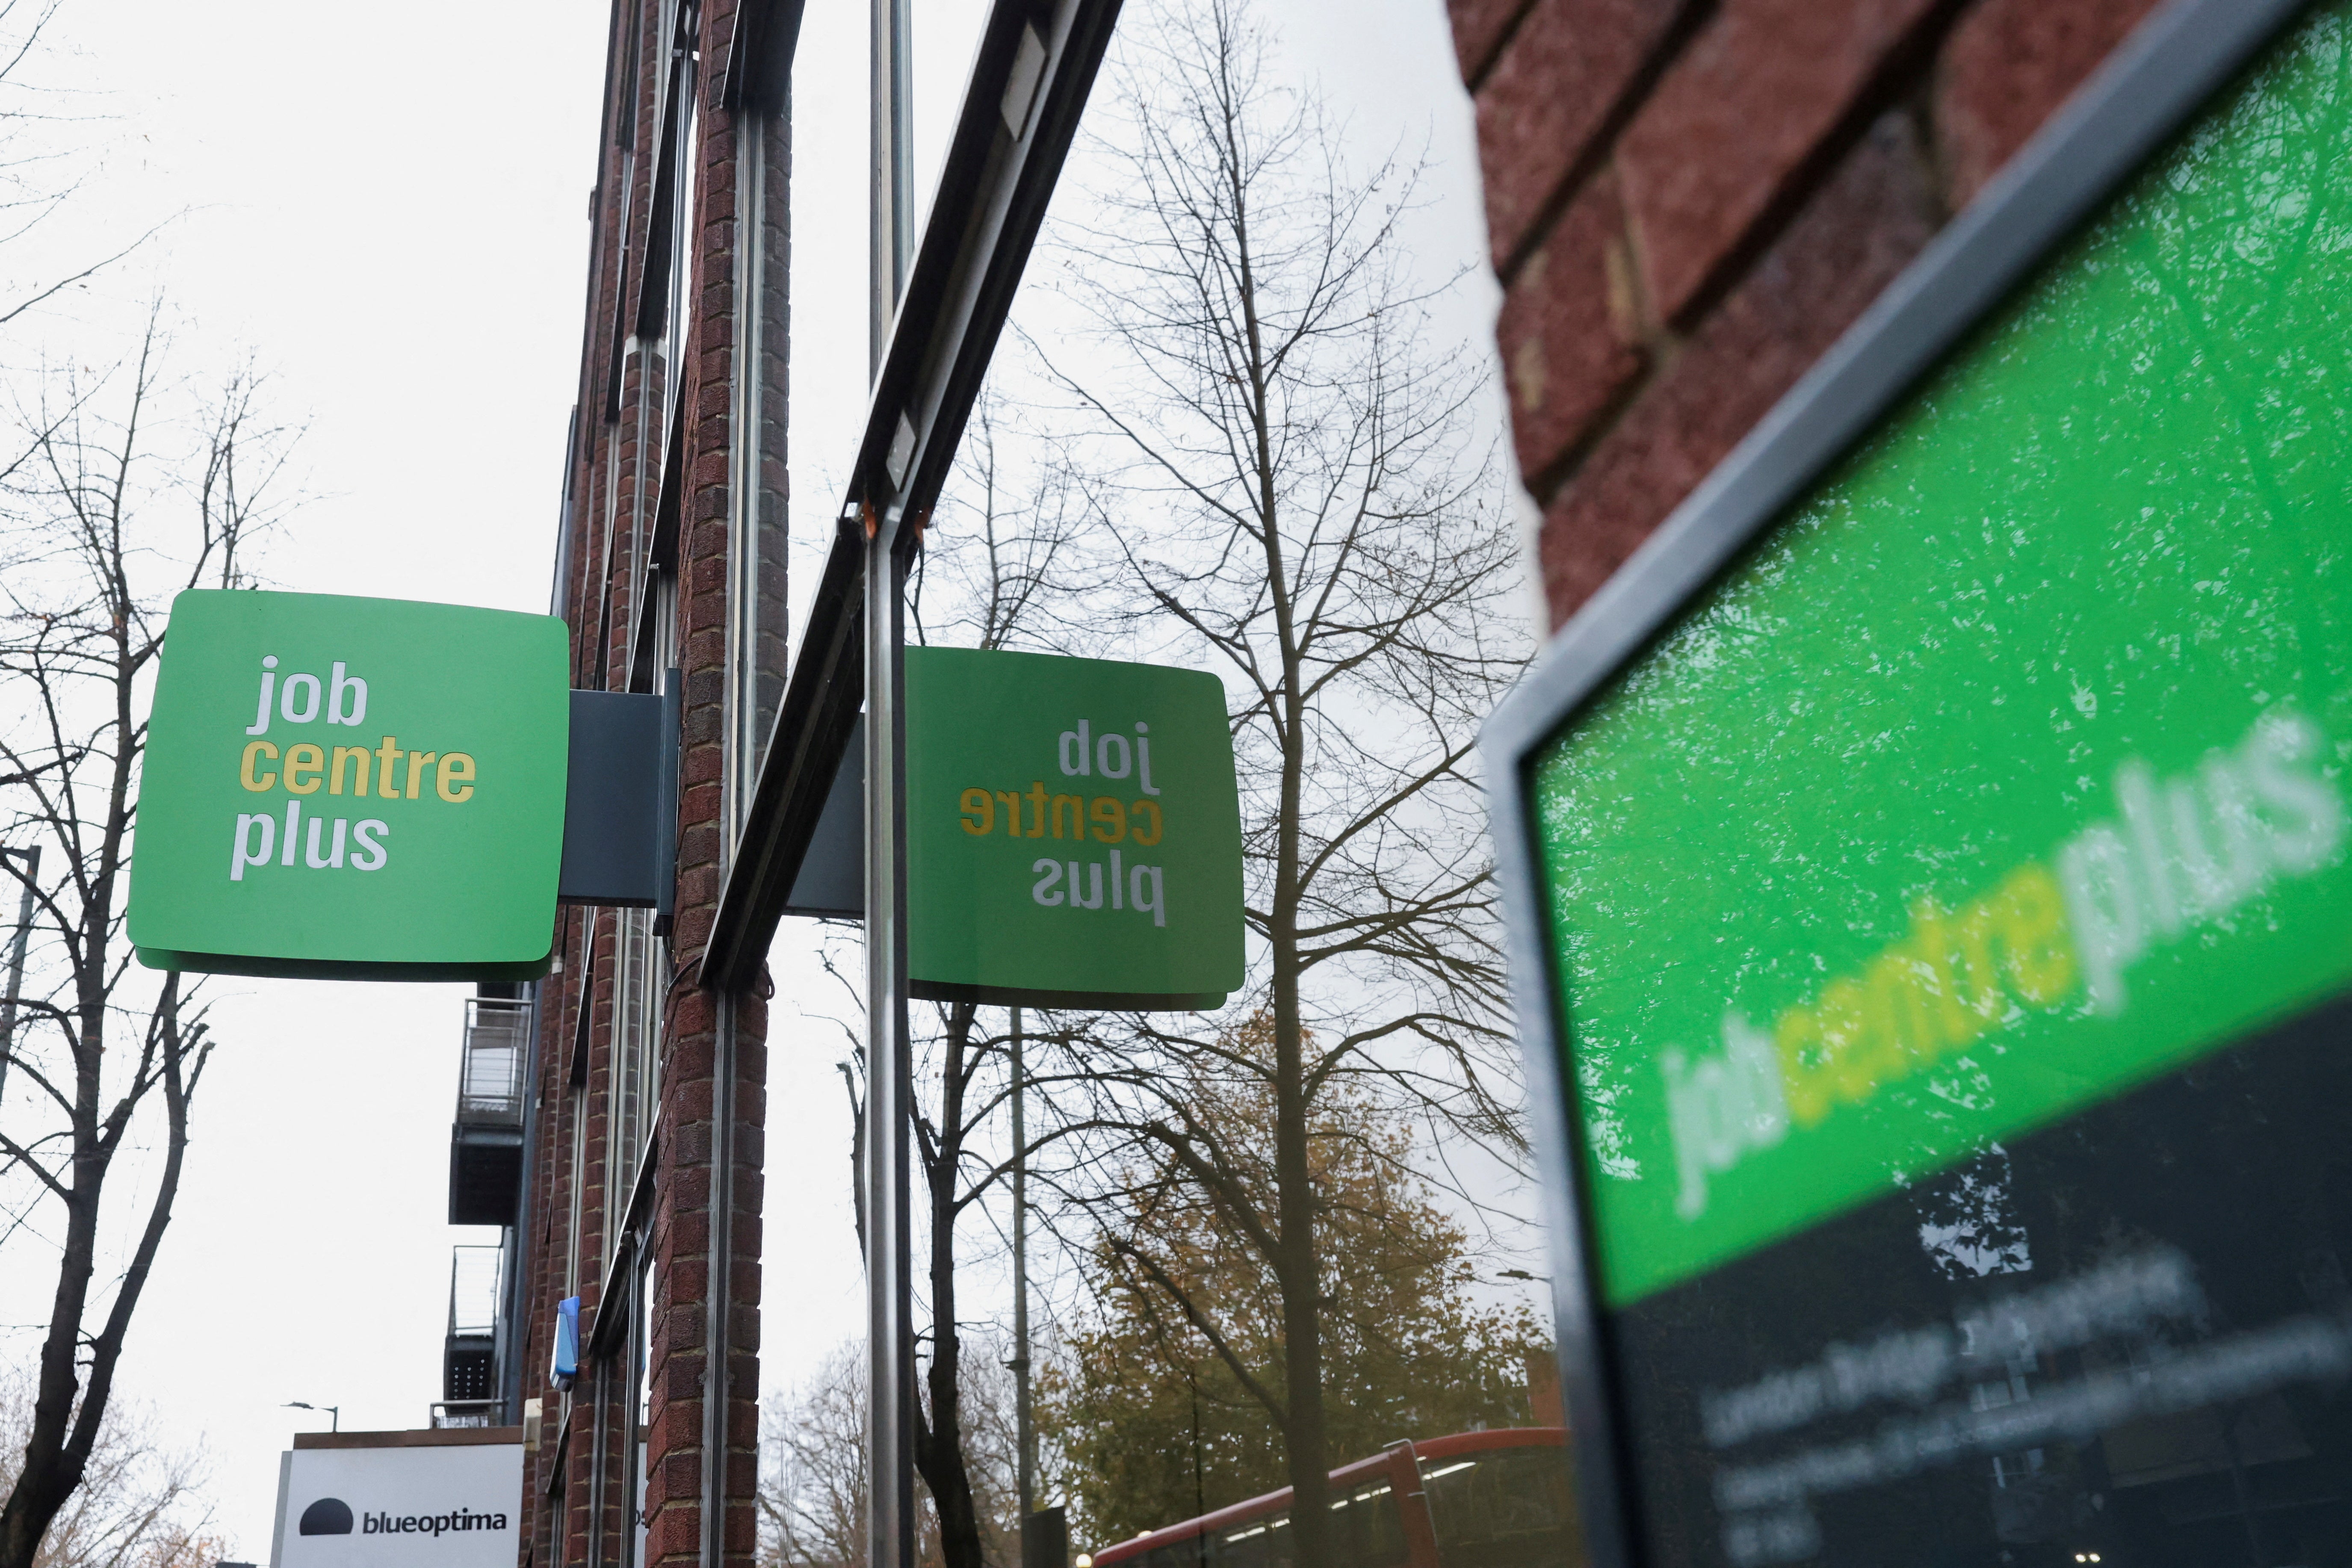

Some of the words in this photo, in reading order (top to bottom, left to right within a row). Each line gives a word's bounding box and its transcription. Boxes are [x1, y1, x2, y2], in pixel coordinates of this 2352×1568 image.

[245, 655, 368, 735] job
[240, 736, 476, 803] centre
[230, 800, 389, 881] plus
[363, 1507, 507, 1537] blueoptima
